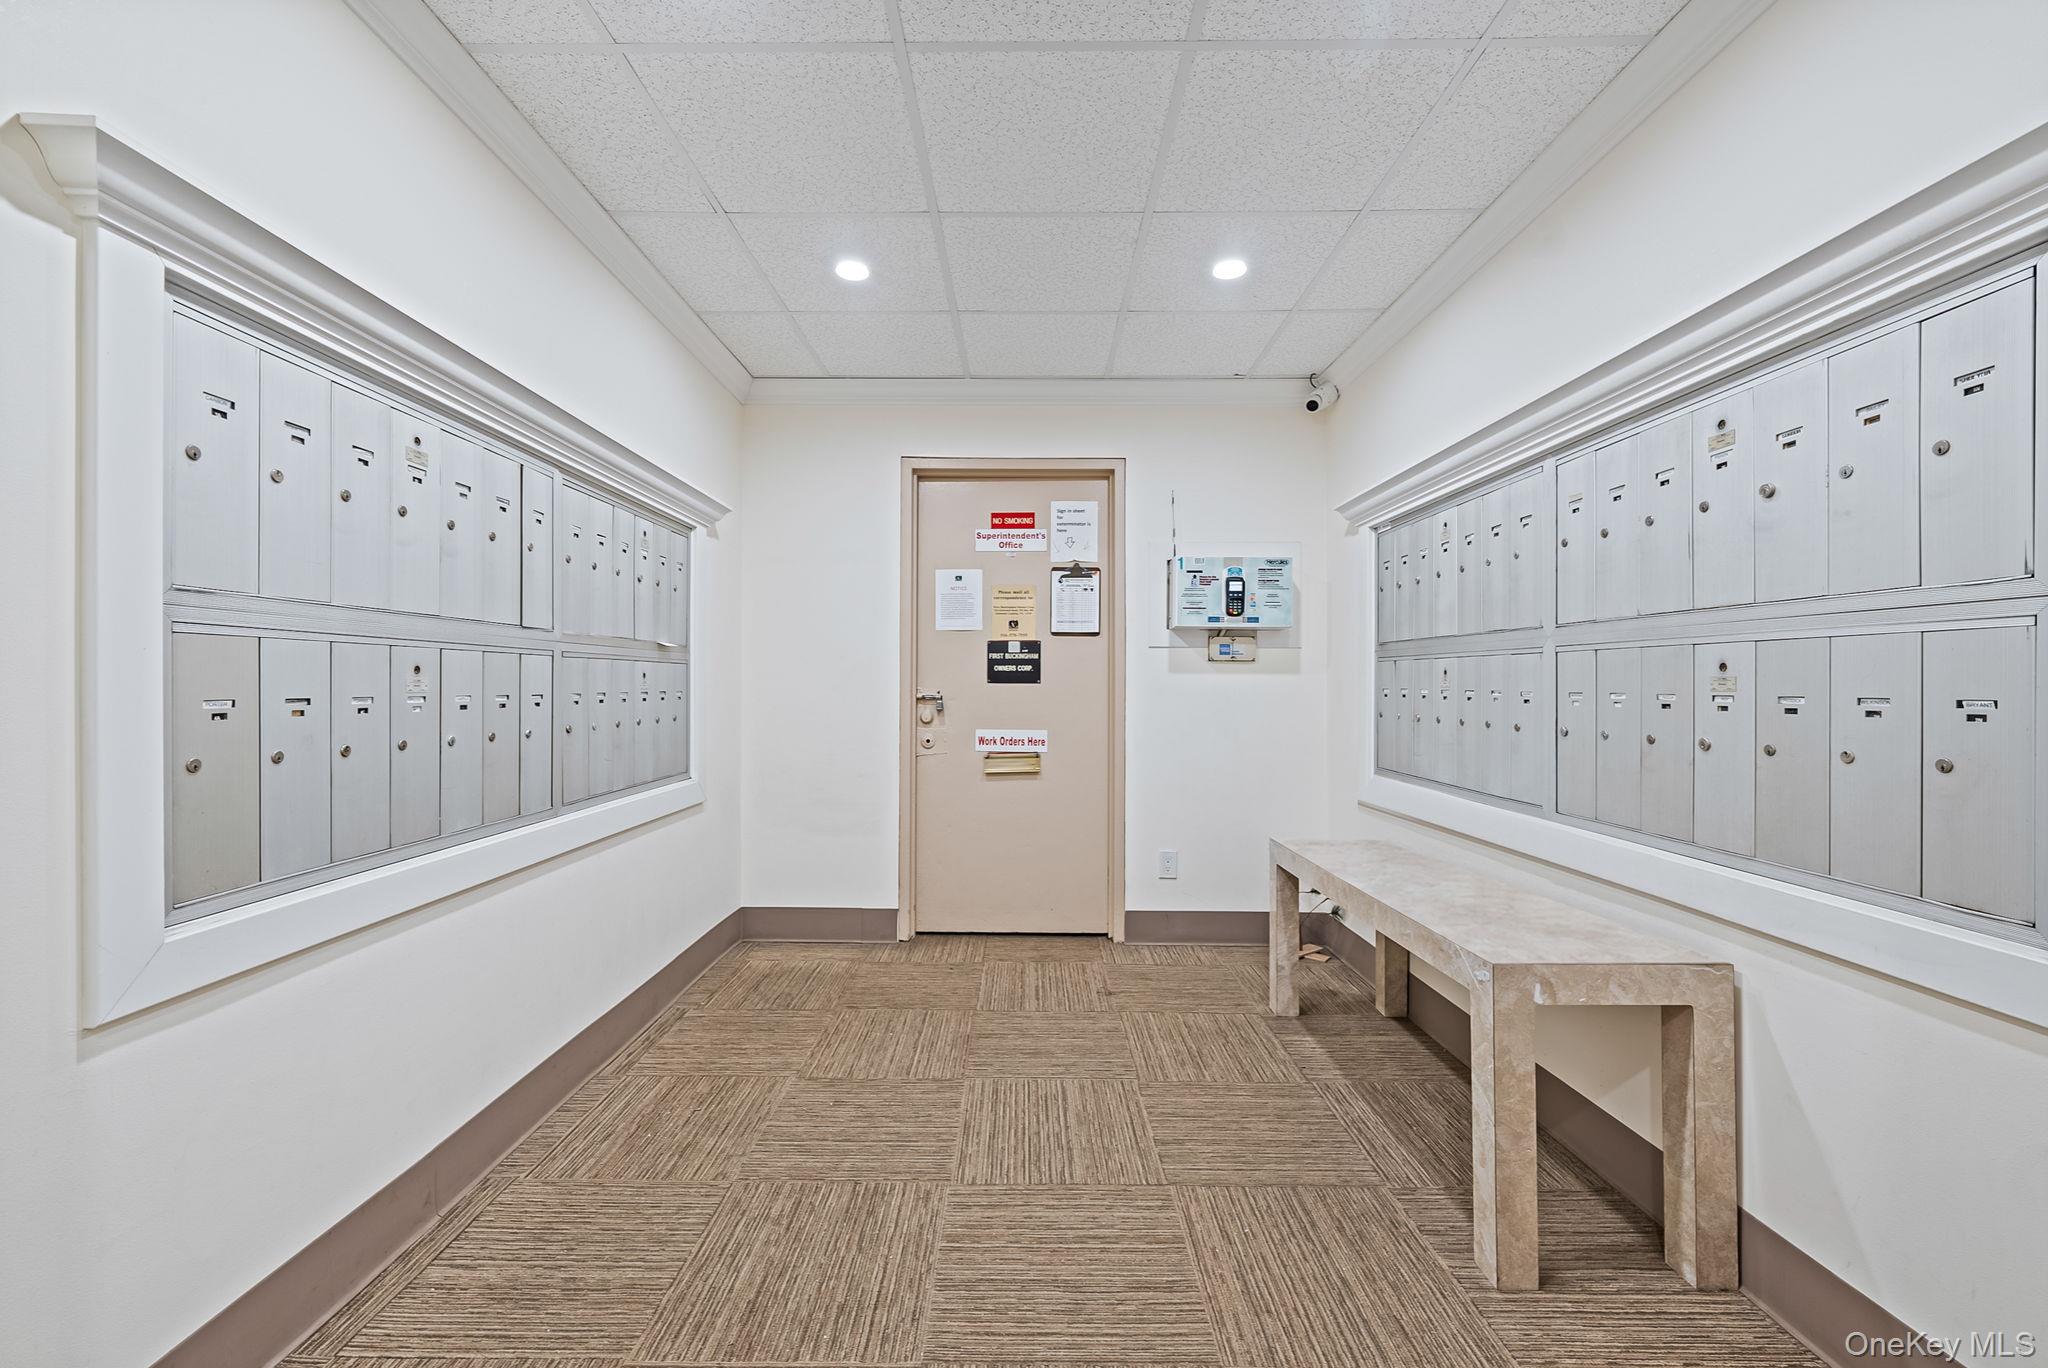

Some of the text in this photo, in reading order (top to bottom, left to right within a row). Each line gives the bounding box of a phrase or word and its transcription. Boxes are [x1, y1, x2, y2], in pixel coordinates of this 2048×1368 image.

[992, 517, 1034, 525] NO SMOKING
[976, 532, 1046, 541] Superintendent's
[998, 541, 1024, 549] Office
[1178, 557, 1184, 570] 1
[977, 735, 1046, 747] Work Orders Here
